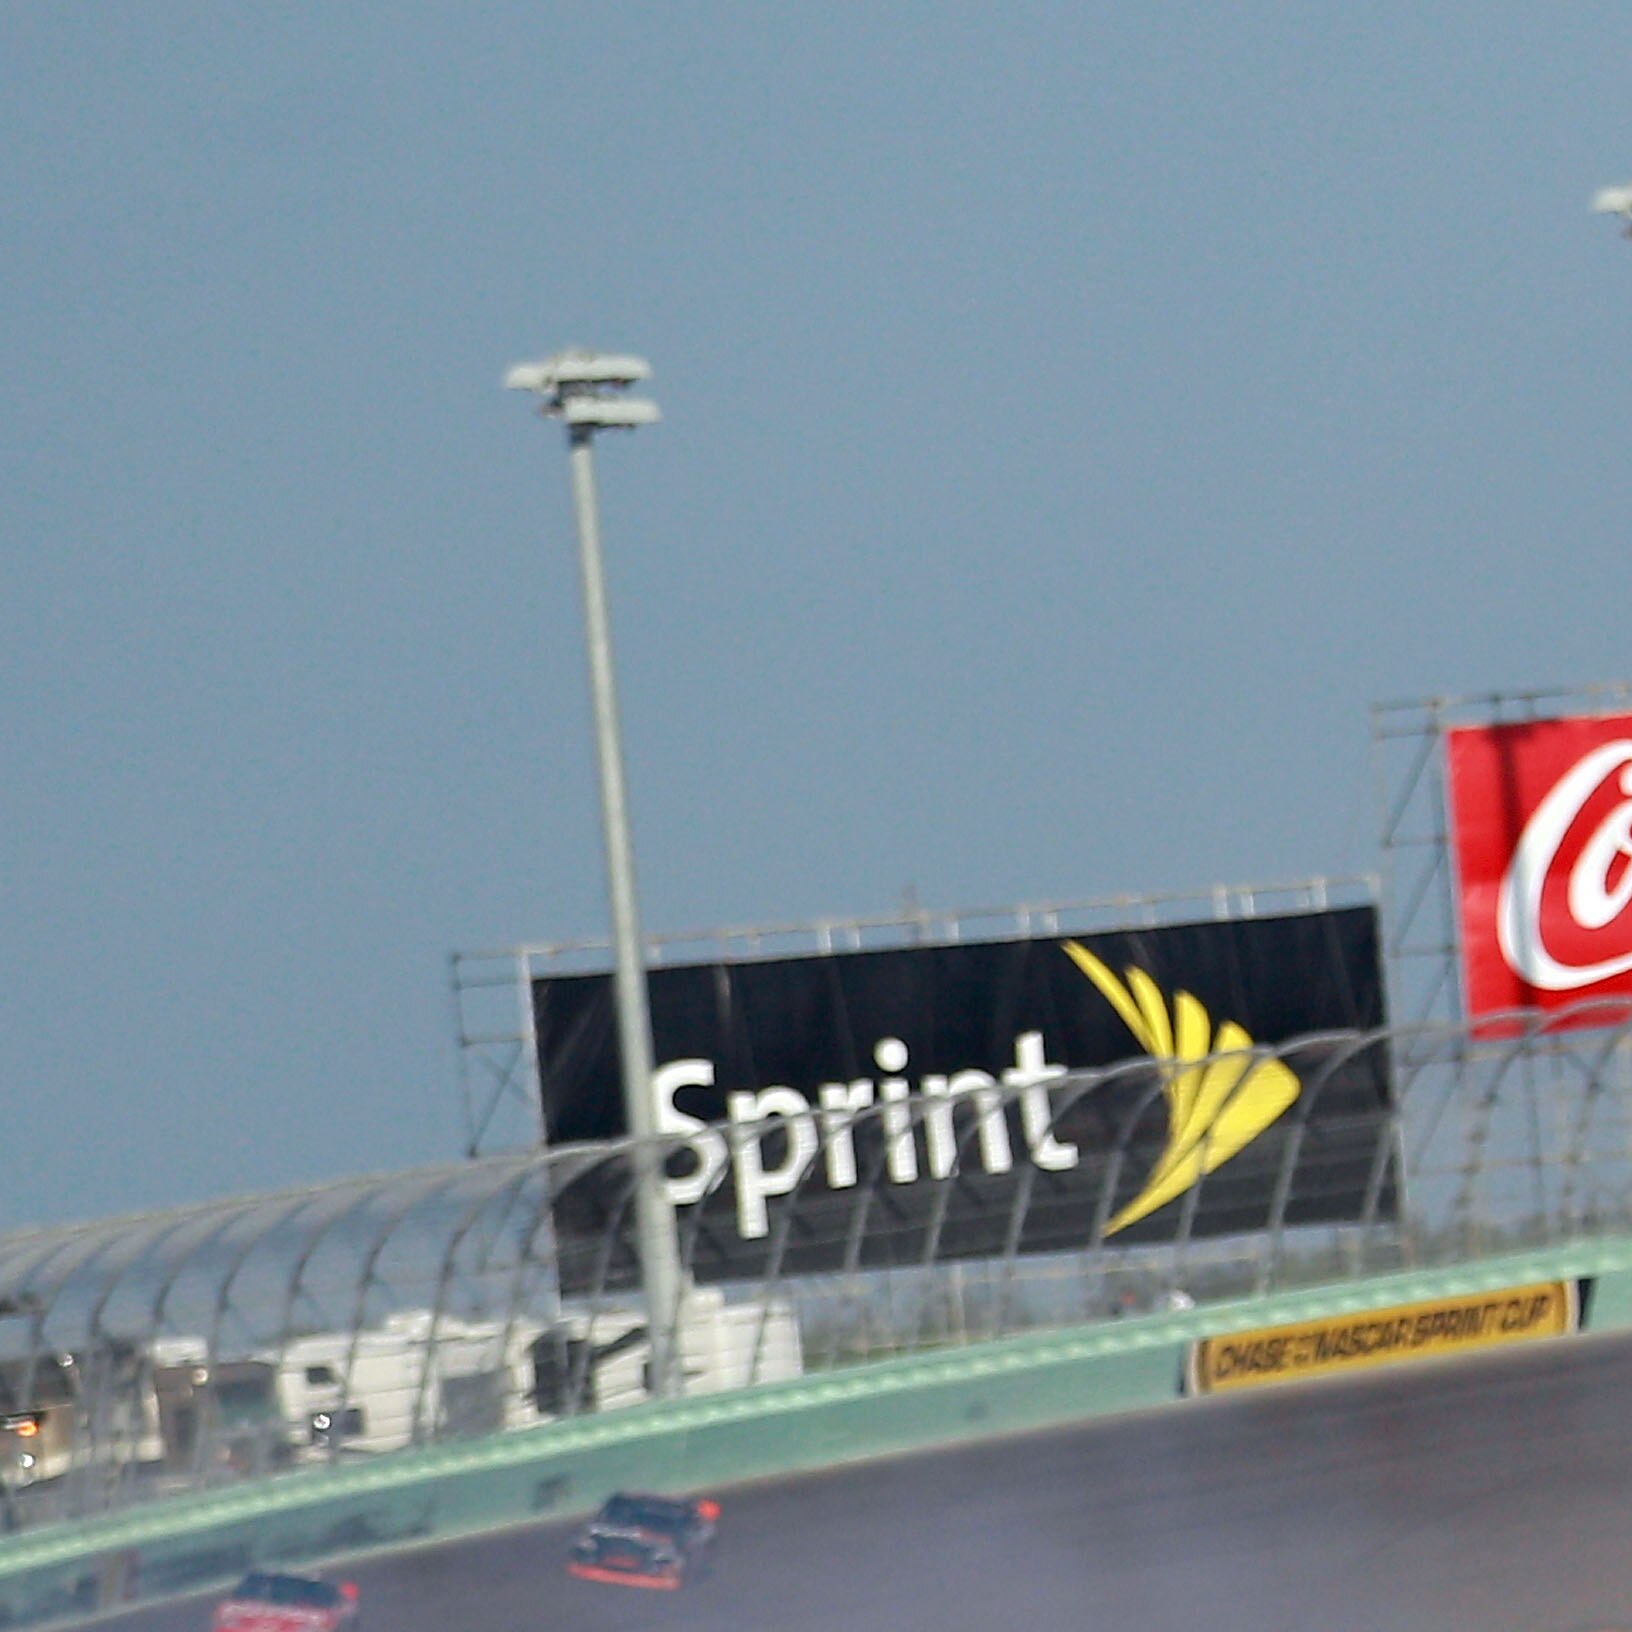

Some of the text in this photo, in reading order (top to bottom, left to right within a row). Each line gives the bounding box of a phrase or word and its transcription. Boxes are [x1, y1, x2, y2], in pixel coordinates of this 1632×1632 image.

[652, 1030, 1079, 1239] Sprint
[1215, 1338, 1290, 1379] CHASE
[1313, 1315, 1409, 1363] NASCAR
[1413, 1302, 1498, 1348] SPRINT
[1501, 1294, 1550, 1331] CUP
